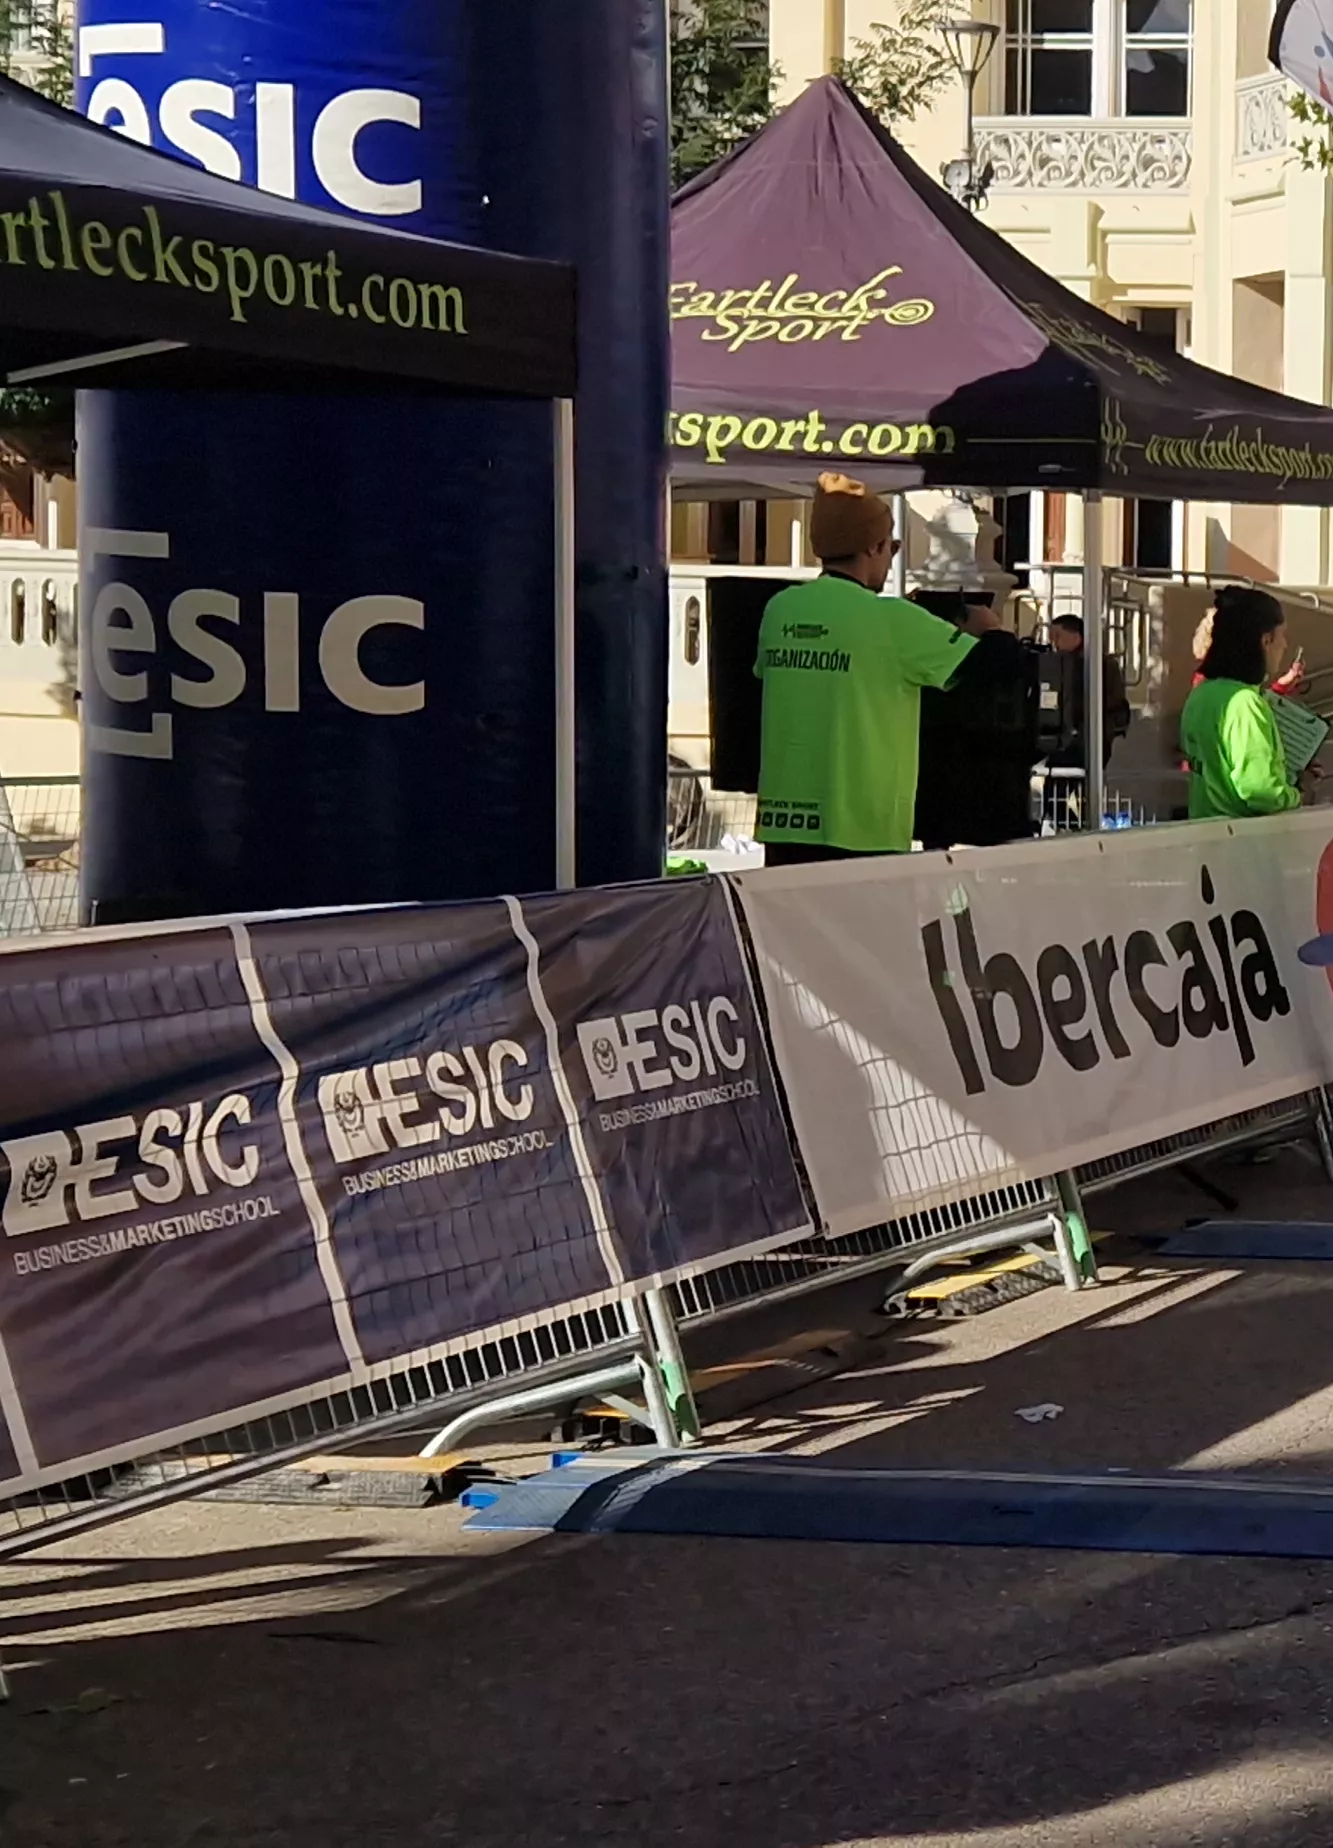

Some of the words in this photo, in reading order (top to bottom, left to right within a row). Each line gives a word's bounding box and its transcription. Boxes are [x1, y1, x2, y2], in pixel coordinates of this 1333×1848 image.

[701, 308, 870, 352] Sport
[921, 864, 1290, 1095] Ibercaja
[373, 1039, 534, 1148] ESIC
[620, 996, 746, 1092] ESIC
[73, 1093, 259, 1221] ESIC
